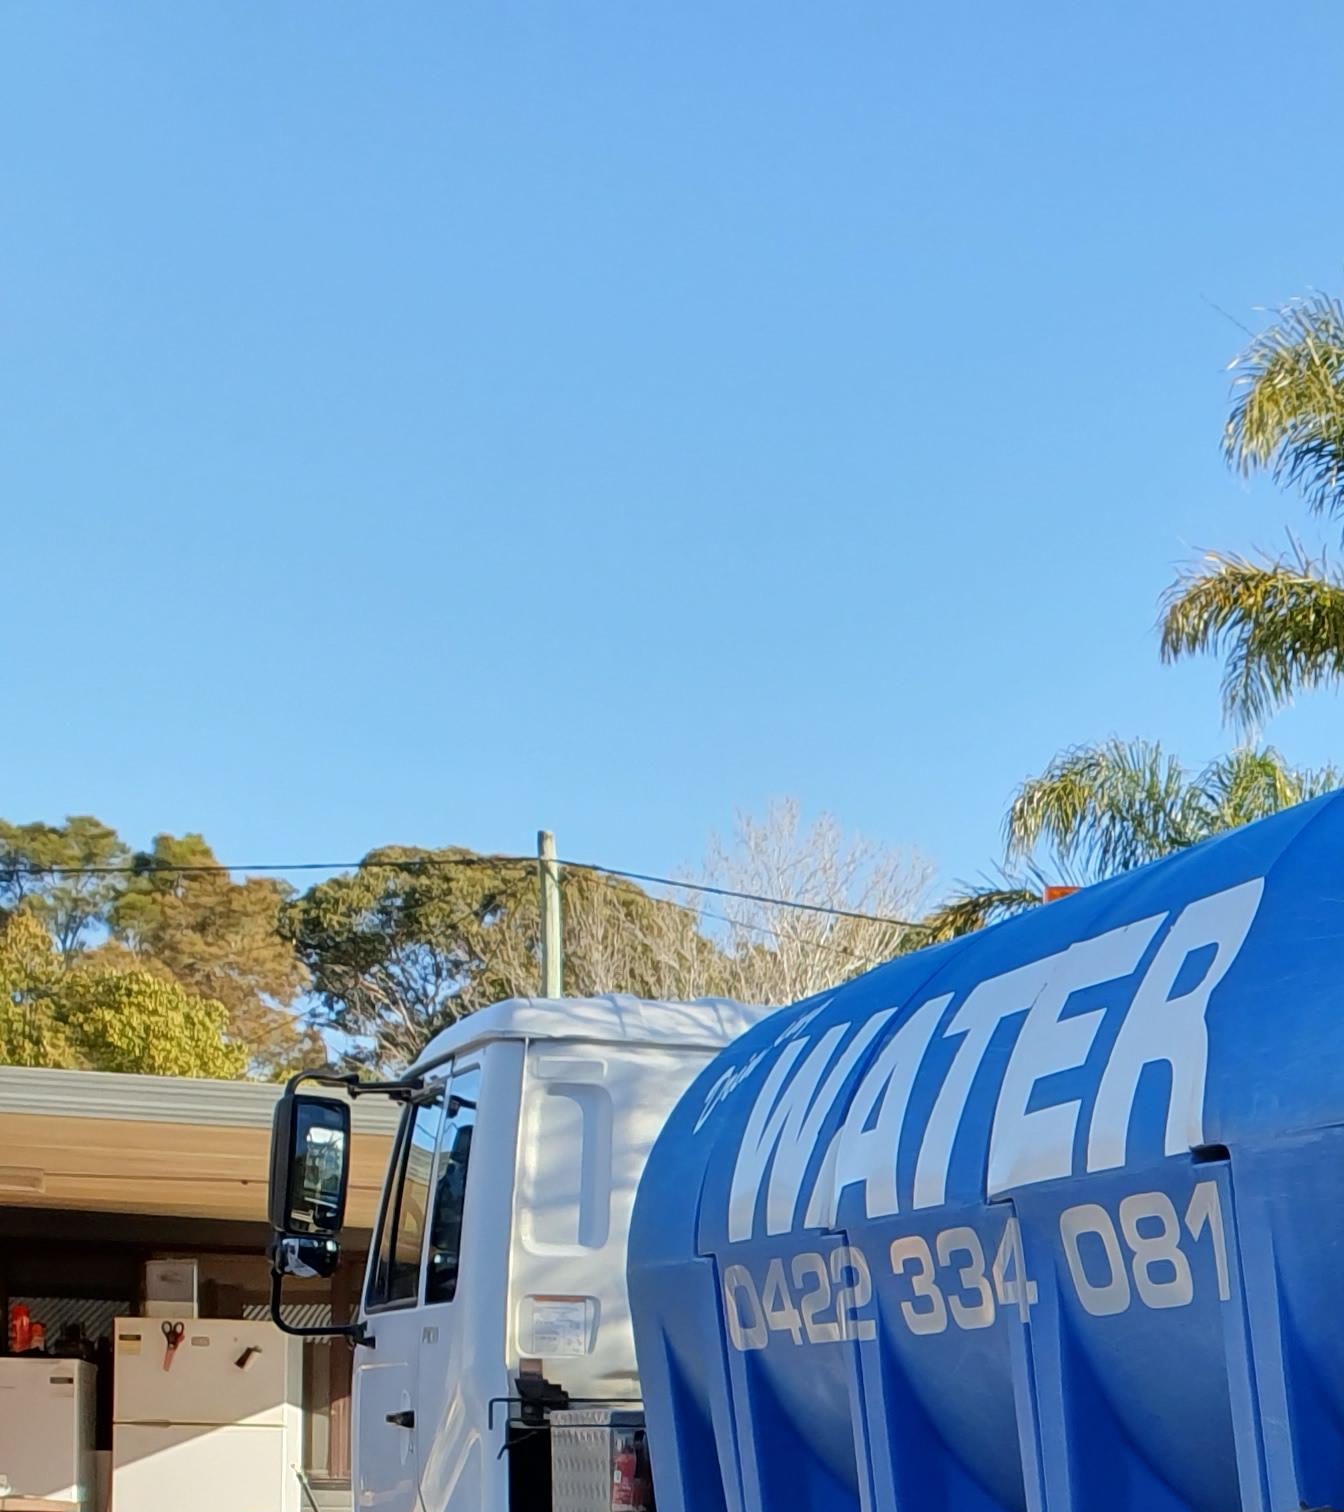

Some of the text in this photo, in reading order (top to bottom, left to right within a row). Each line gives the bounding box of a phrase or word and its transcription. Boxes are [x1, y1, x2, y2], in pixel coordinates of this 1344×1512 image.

[727, 876, 1265, 1243] WATER
[724, 1245, 877, 1352] 0422
[891, 1217, 1038, 1336] 334
[1060, 1180, 1231, 1317] 081
